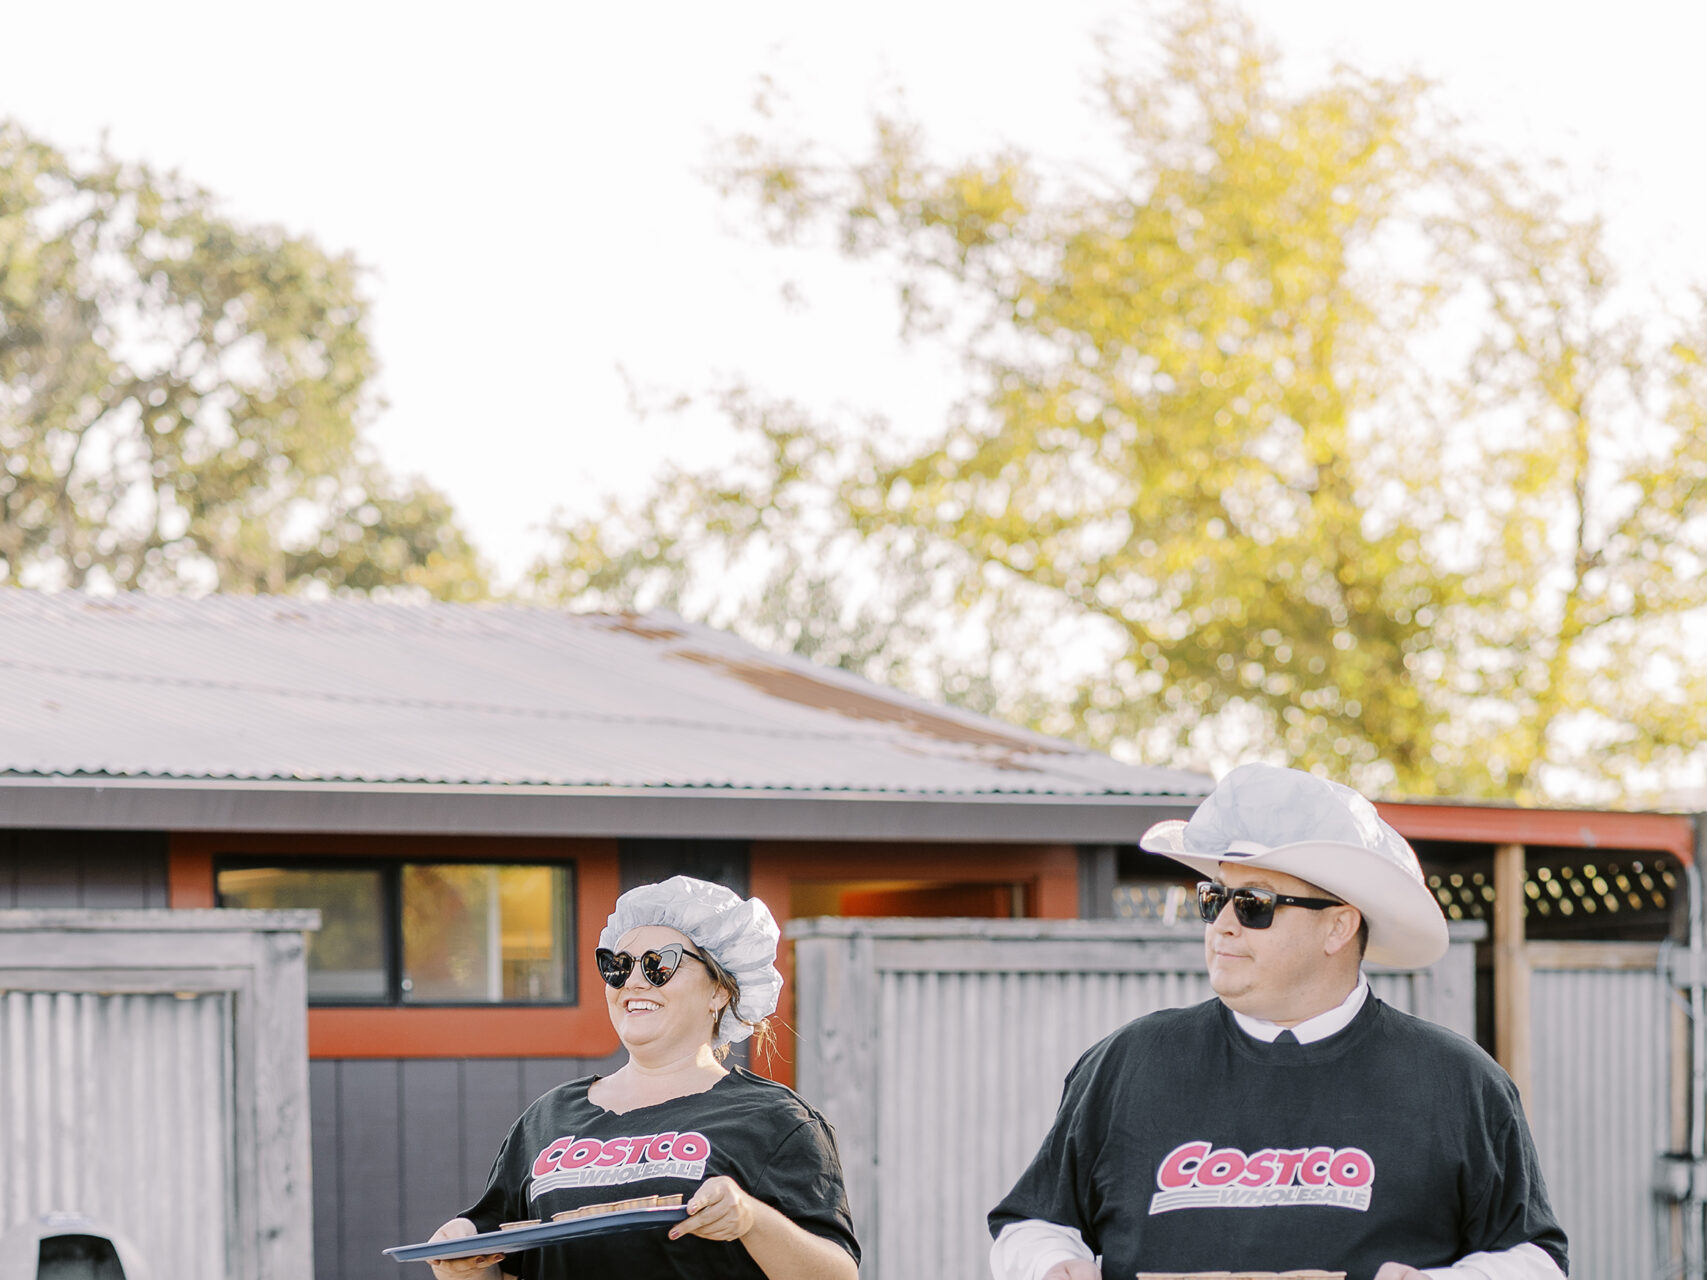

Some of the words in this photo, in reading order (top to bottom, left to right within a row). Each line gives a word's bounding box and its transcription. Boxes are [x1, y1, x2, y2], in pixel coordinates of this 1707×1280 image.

[532, 1132, 710, 1178] COSTCO
[1157, 1141, 1375, 1190] COSTCO
[578, 1161, 704, 1185] WHOLESALE
[1217, 1187, 1368, 1209] WHOLESALE
